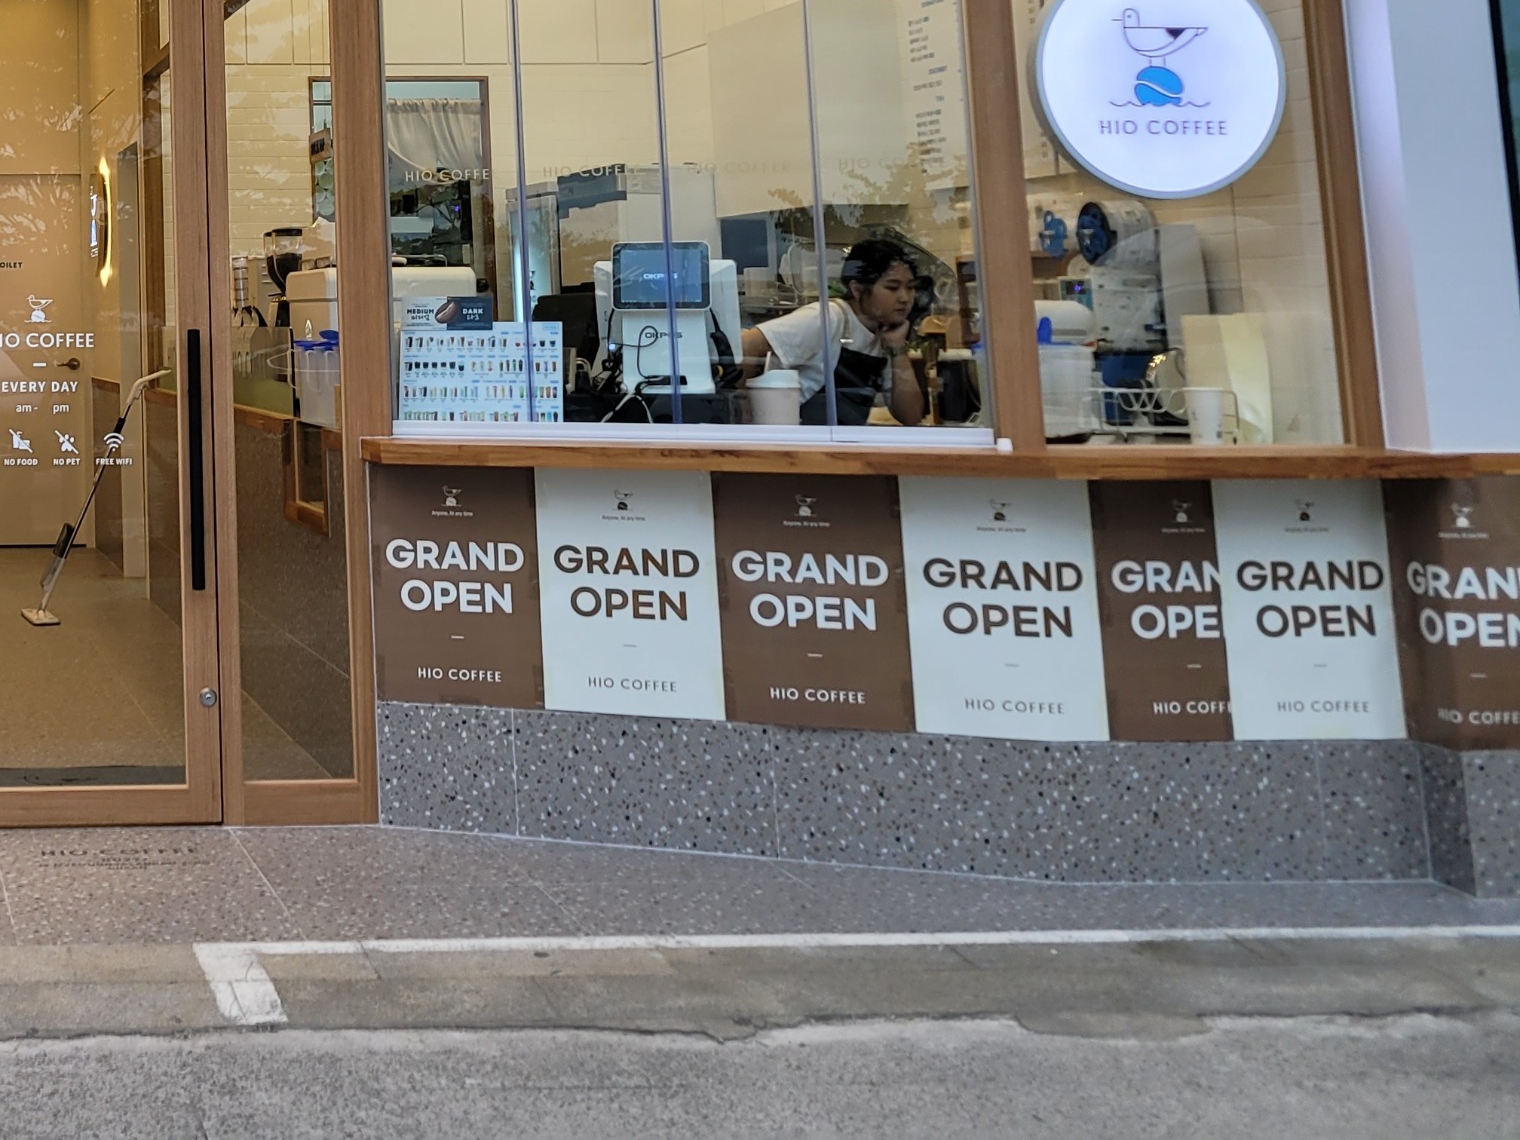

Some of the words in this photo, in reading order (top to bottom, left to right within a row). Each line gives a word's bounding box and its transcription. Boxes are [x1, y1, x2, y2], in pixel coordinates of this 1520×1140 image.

[1099, 119, 1138, 135] HIO
[1147, 119, 1228, 136] COFFEE
[405, 170, 433, 183] HIO
[542, 166, 573, 178] HIO
[643, 272, 679, 280] OKPS
[26, 333, 95, 348] COFFEE
[645, 331, 684, 339] OKPS
[1, 381, 46, 393] EVERY
[51, 381, 79, 393] DAY
[52, 404, 70, 415] pm
[4, 458, 16, 466] NO
[17, 458, 38, 466] FOOD
[53, 458, 64, 466] NO
[65, 458, 81, 466] PET
[95, 458, 113, 466] FREE
[385, 539, 525, 573] GRAND
[553, 544, 701, 578] GRAND
[731, 549, 890, 587] GRAND
[922, 557, 1084, 593] GRAND
[1235, 559, 1385, 594] GRAND
[1406, 561, 1520, 601] GRAN
[399, 579, 514, 614] OPEN
[570, 586, 689, 622] OPEN
[749, 593, 878, 632] OPEN
[942, 601, 1074, 639] OPEN
[1255, 603, 1378, 639] OPEN
[1130, 604, 1226, 640] OPE
[417, 666, 444, 681] HIO
[448, 668, 503, 684] COFFEE
[587, 676, 615, 690] HIO
[620, 678, 678, 693] COFFEE
[769, 686, 800, 703] HIO
[804, 688, 867, 705] COFFEE
[964, 697, 997, 712] HIO
[1001, 699, 1066, 716] COFFEE
[1153, 701, 1182, 716] HIO
[1276, 700, 1306, 714] HIO
[1310, 700, 1371, 714] COFFEE
[1437, 707, 1464, 725] HIO
